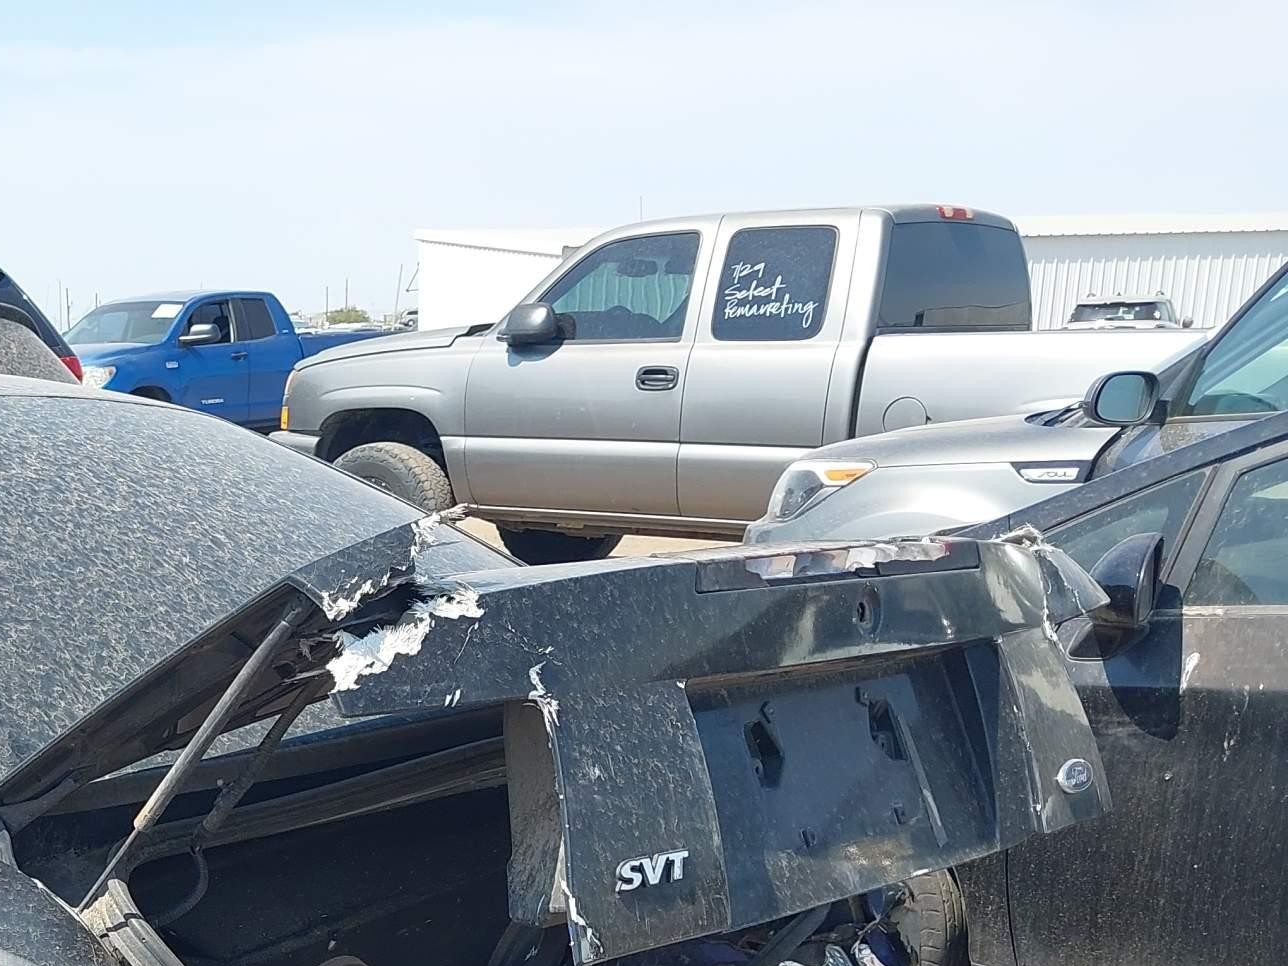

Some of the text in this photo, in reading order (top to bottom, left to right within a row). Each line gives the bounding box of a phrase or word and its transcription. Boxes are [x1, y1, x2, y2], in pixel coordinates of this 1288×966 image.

[731, 261, 766, 285] 7/29
[724, 274, 787, 301] Select
[615, 849, 689, 892] SVT
